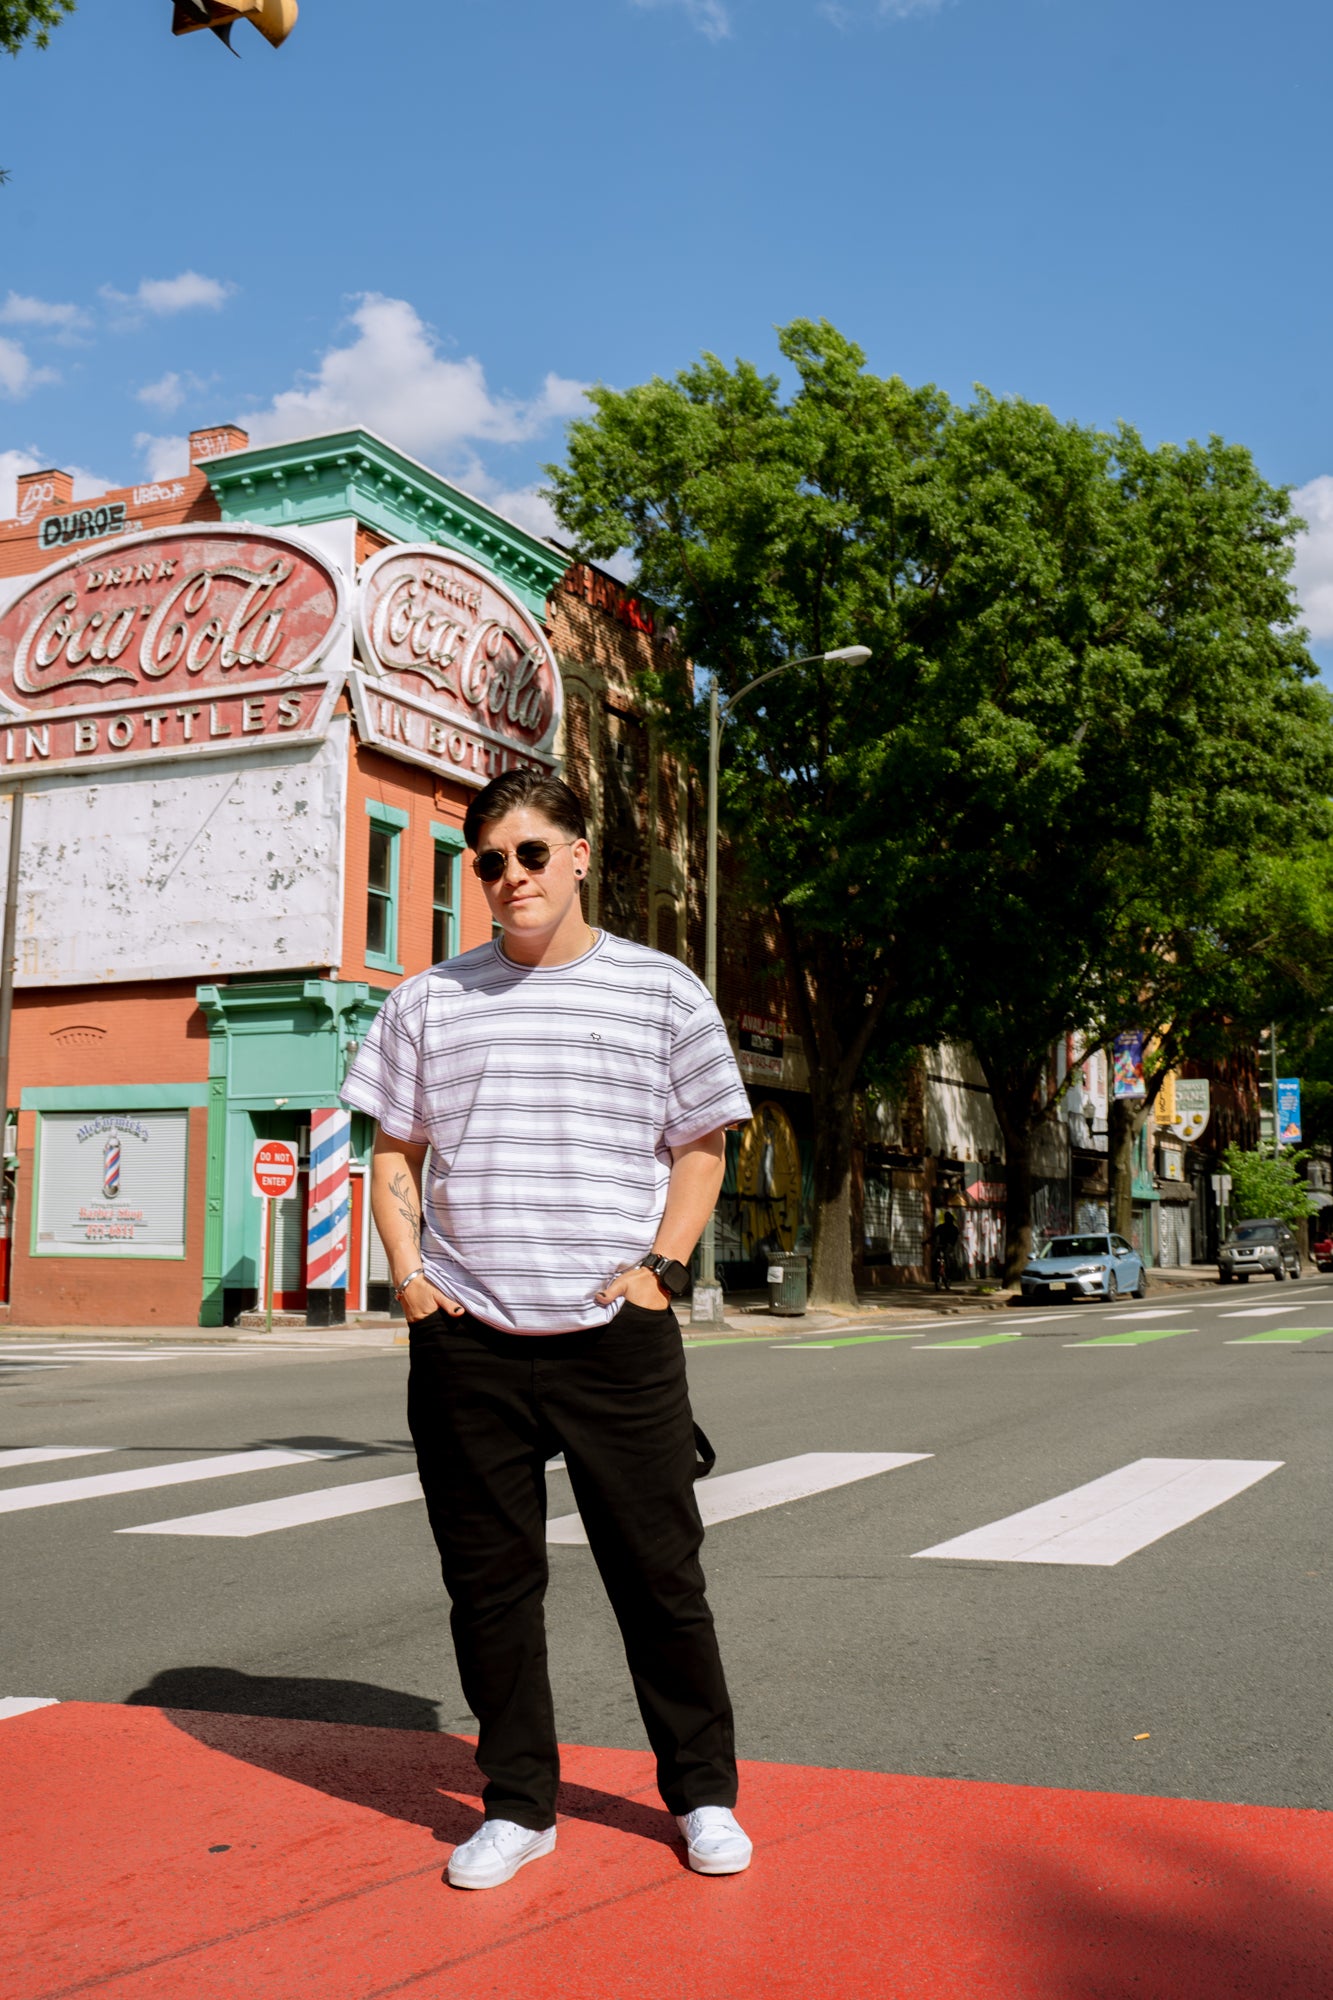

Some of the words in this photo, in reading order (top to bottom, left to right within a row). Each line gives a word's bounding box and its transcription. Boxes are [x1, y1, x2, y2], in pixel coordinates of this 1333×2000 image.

[85, 559, 179, 592] DRINK
[421, 567, 482, 610] DRINK
[13, 558, 296, 693] Coca-Cola
[372, 573, 548, 731] Coca-Cola
[5, 724, 50, 760] IN
[74, 690, 305, 753] BOTTLES
[379, 699, 412, 745] IN
[260, 1151, 272, 1162] DO
[274, 1152, 291, 1163] NOT
[261, 1175, 287, 1187] ENTER
